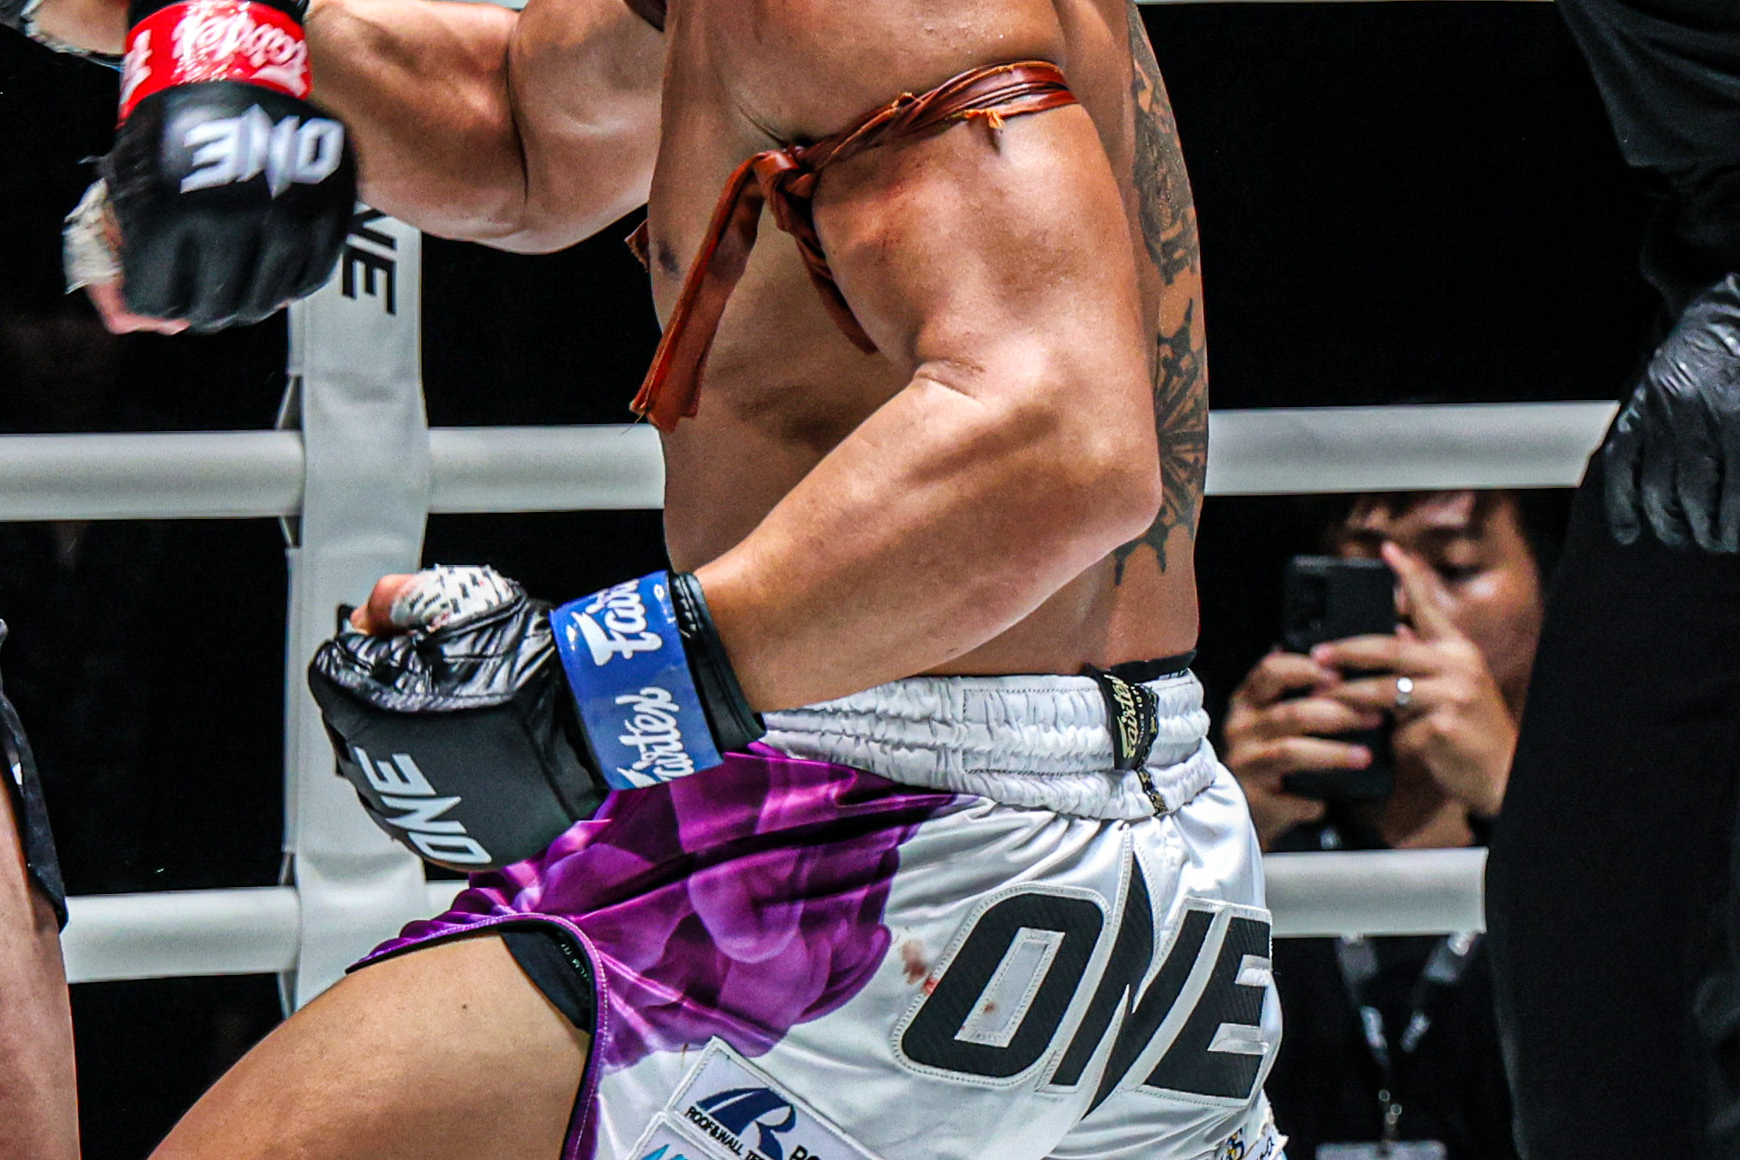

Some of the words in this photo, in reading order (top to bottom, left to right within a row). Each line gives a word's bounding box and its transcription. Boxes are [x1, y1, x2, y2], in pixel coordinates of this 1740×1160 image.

[180, 103, 345, 200] ONE
[354, 746, 492, 865] ONE
[896, 848, 1272, 1121] ONE
